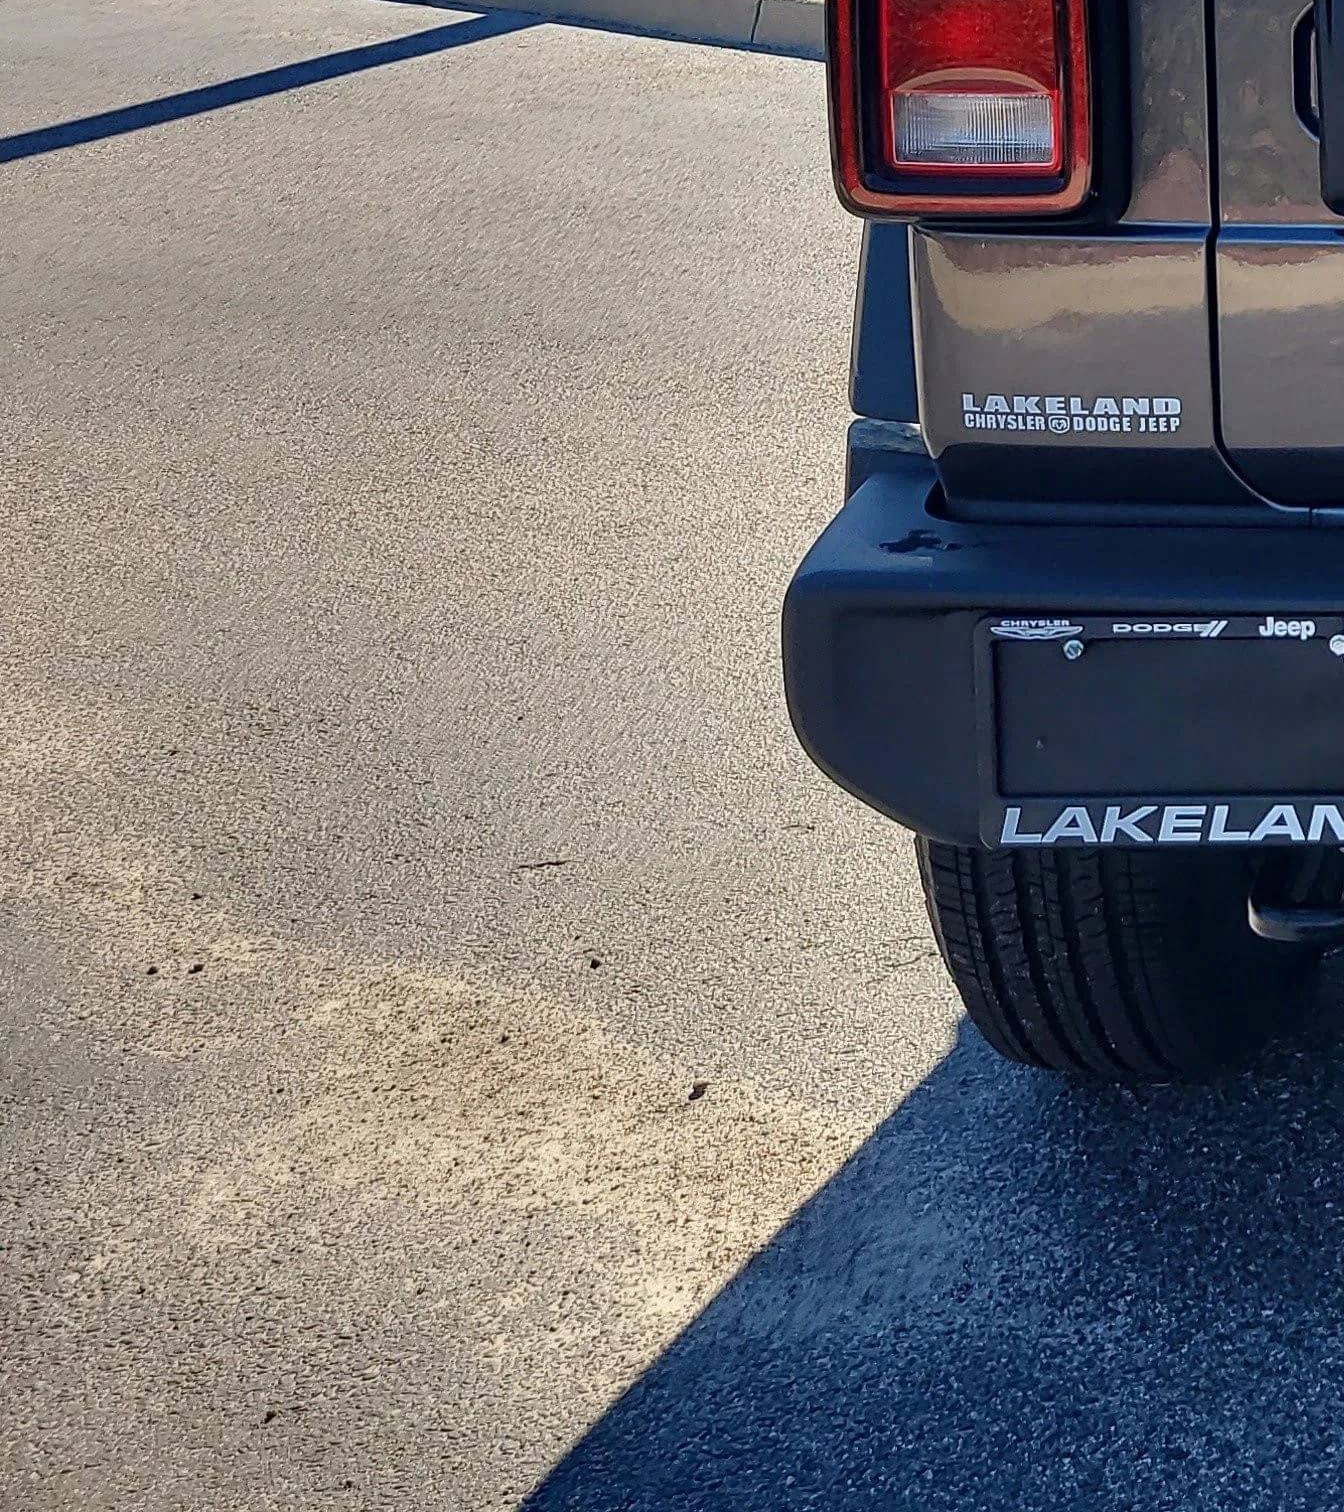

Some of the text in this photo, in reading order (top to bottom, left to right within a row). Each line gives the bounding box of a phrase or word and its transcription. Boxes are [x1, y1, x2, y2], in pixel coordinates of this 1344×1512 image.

[961, 393, 1182, 416] LAKELAND
[964, 413, 1181, 432] CHRYSLER DODGE JEEP
[1000, 619, 1071, 628] CHRYSLER
[1112, 622, 1209, 634] DODGE
[1258, 616, 1316, 640] Jeep
